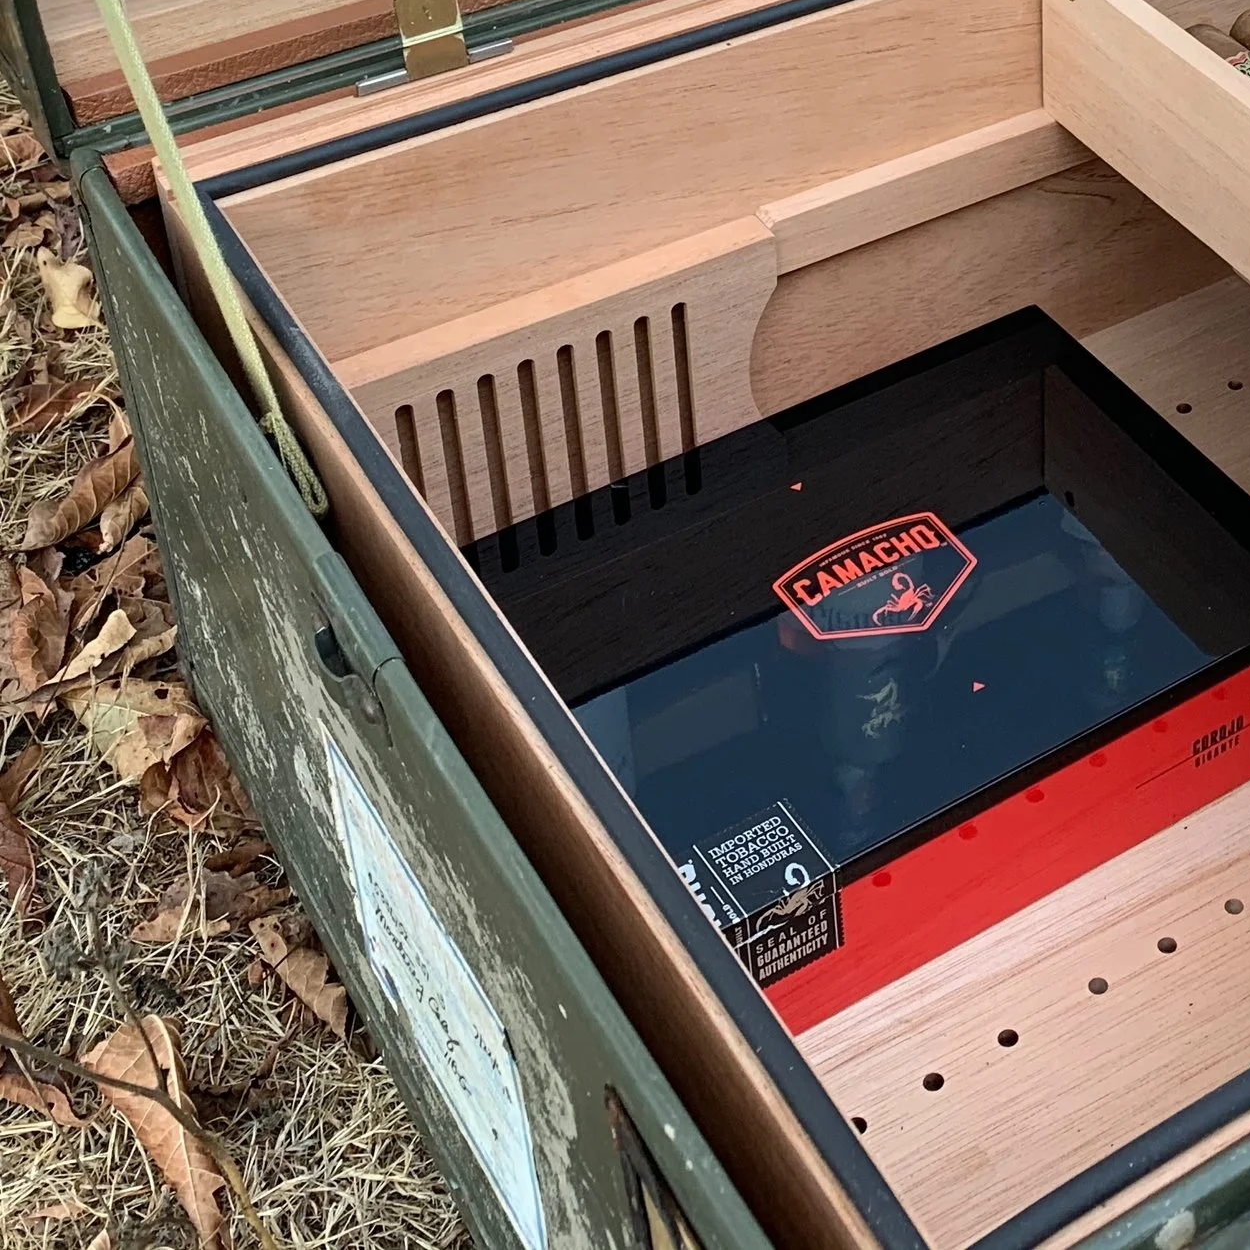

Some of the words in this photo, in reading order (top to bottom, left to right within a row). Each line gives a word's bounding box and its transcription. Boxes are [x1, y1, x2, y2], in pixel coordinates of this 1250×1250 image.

[792, 524, 941, 607] CAMACHO
[856, 576, 877, 588] BUILT
[878, 565, 899, 577] BOLD
[1193, 715, 1244, 755] COROJO
[1195, 735, 1240, 768] GIGANTE
[708, 816, 782, 859] IMPORTED
[716, 825, 789, 869] TOBACCO
[723, 854, 760, 878] HAND
[761, 834, 797, 859] BUILT
[729, 875, 744, 886] IN
[745, 842, 803, 877] HONDURAS
[756, 927, 798, 954] SEAL
[808, 909, 828, 925] OF
[757, 920, 828, 967] GUARANTEED
[759, 934, 829, 981] AUTHENTICITY
